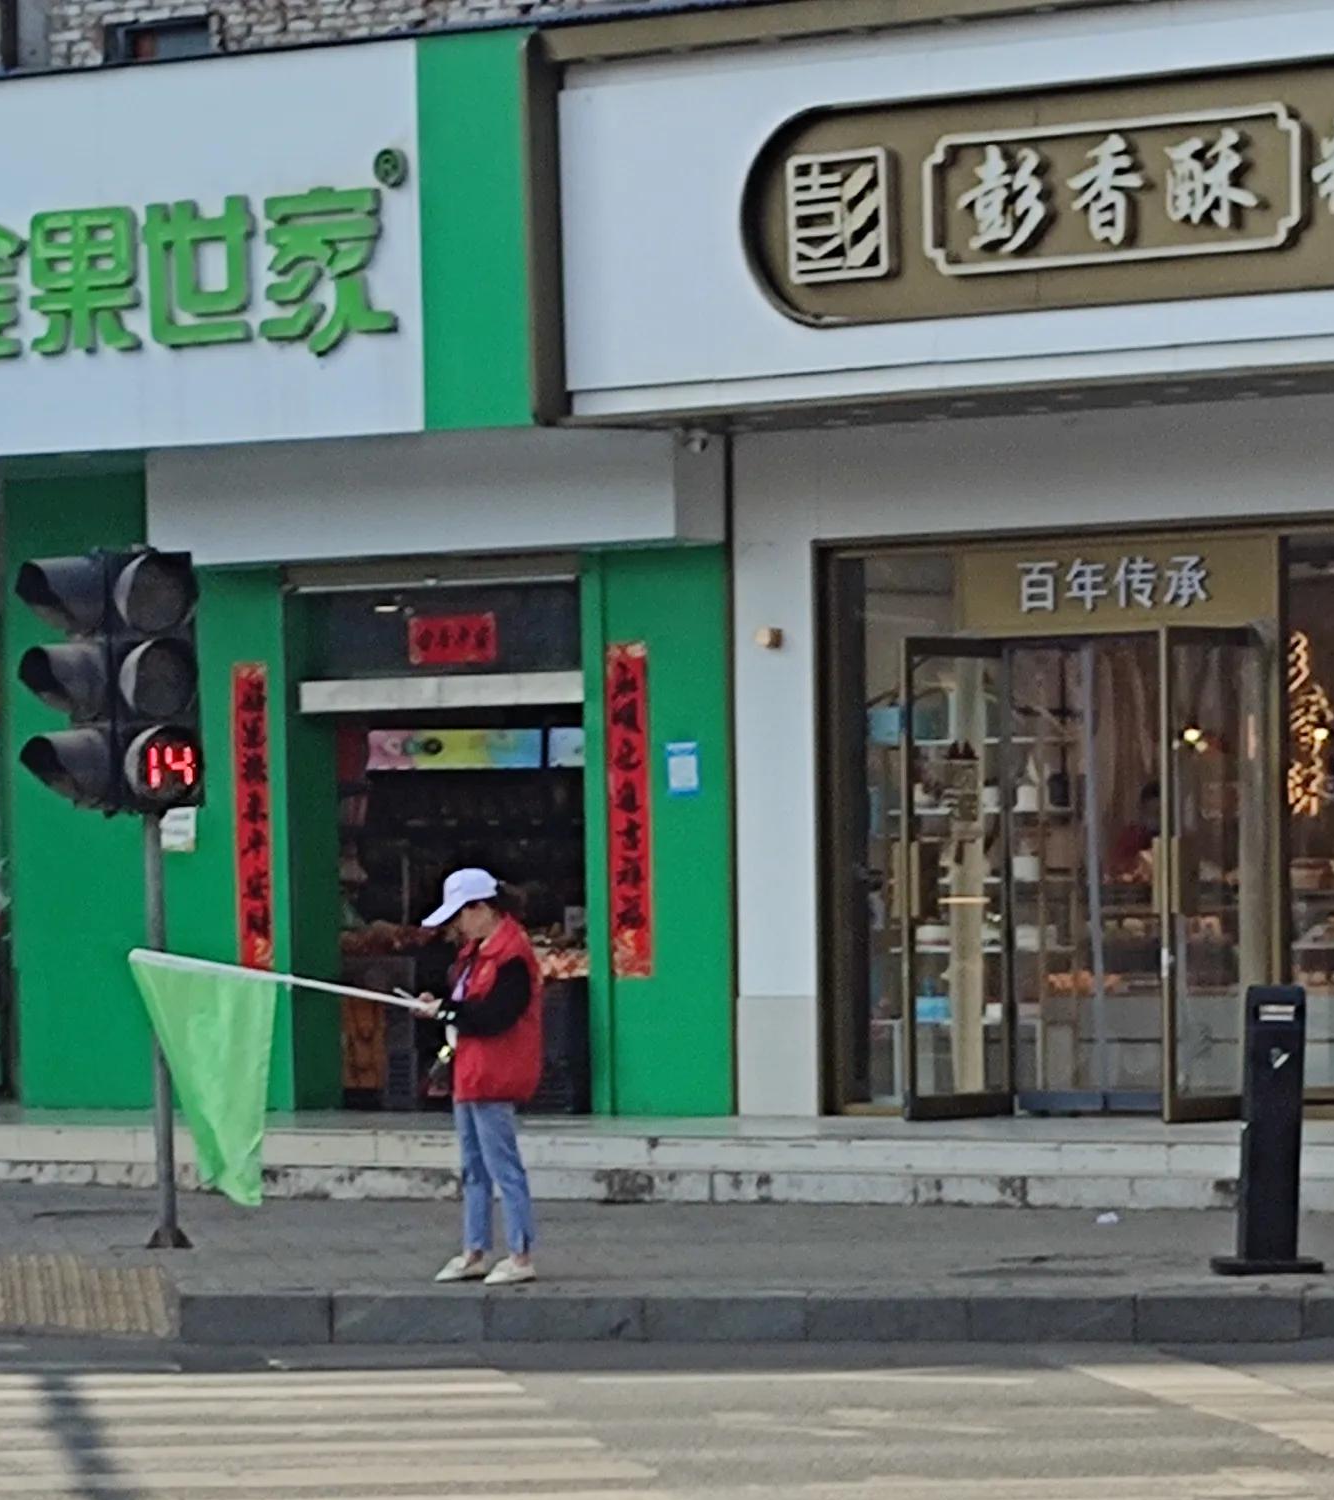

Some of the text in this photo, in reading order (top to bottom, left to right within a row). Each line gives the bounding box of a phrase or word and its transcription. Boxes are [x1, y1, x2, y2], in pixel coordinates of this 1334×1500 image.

[956, 133, 1258, 253] 彭香酥
[1017, 556, 1207, 613] 百年传承
[149, 746, 195, 789] 14
